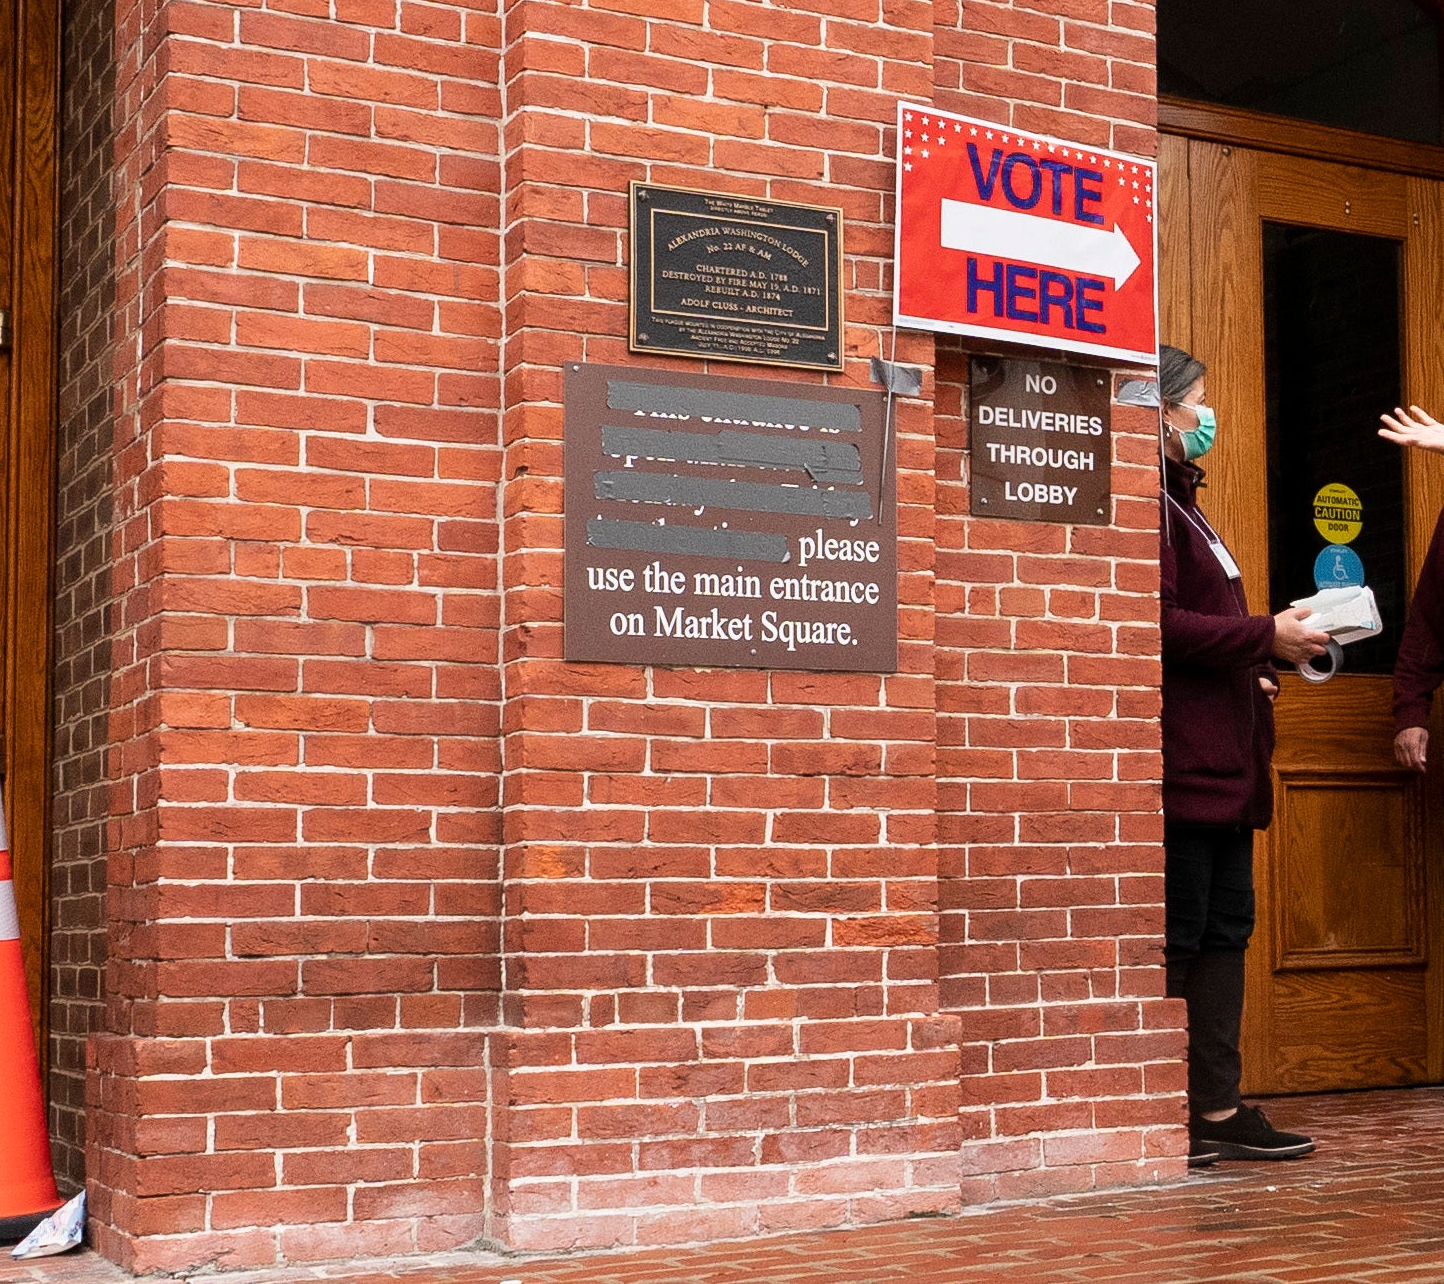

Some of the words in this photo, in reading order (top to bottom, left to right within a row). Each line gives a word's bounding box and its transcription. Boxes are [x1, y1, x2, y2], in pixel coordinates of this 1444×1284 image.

[966, 143, 1105, 225] VOTE
[667, 227, 720, 252] ALEXANDRIA
[722, 227, 782, 248] WASHINGTON
[782, 243, 809, 267] LODGE
[723, 242, 733, 251] 22
[749, 246, 756, 254] &
[757, 248, 772, 261] AM
[662, 270, 713, 283] DESTROYED
[716, 276, 726, 285] BY
[728, 278, 747, 288] FIRE
[749, 281, 767, 290] MAY
[696, 264, 748, 278] CHARTERED
[705, 285, 741, 296] REBUILT
[762, 292, 781, 301] 1874
[967, 258, 1106, 333] HERE
[680, 298, 709, 309] ADOLF
[711, 301, 739, 312] CLUSS
[745, 305, 794, 317] ARCHITECT
[1025, 374, 1057, 395] NO
[978, 405, 1103, 436] DELIVERIES
[986, 443, 1094, 471] THROUGH
[1004, 481, 1078, 505] LOBBY
[1317, 496, 1360, 506] AUTOMATIC
[1315, 506, 1360, 521] CAUTION
[1328, 523, 1349, 532] DOOR
[798, 529, 880, 566] please
[587, 567, 635, 592] use
[643, 561, 686, 594] the
[694, 566, 762, 598] main
[769, 573, 880, 604] entrance
[609, 612, 646, 636] on
[653, 606, 753, 640] Market
[760, 611, 859, 652] Square.
